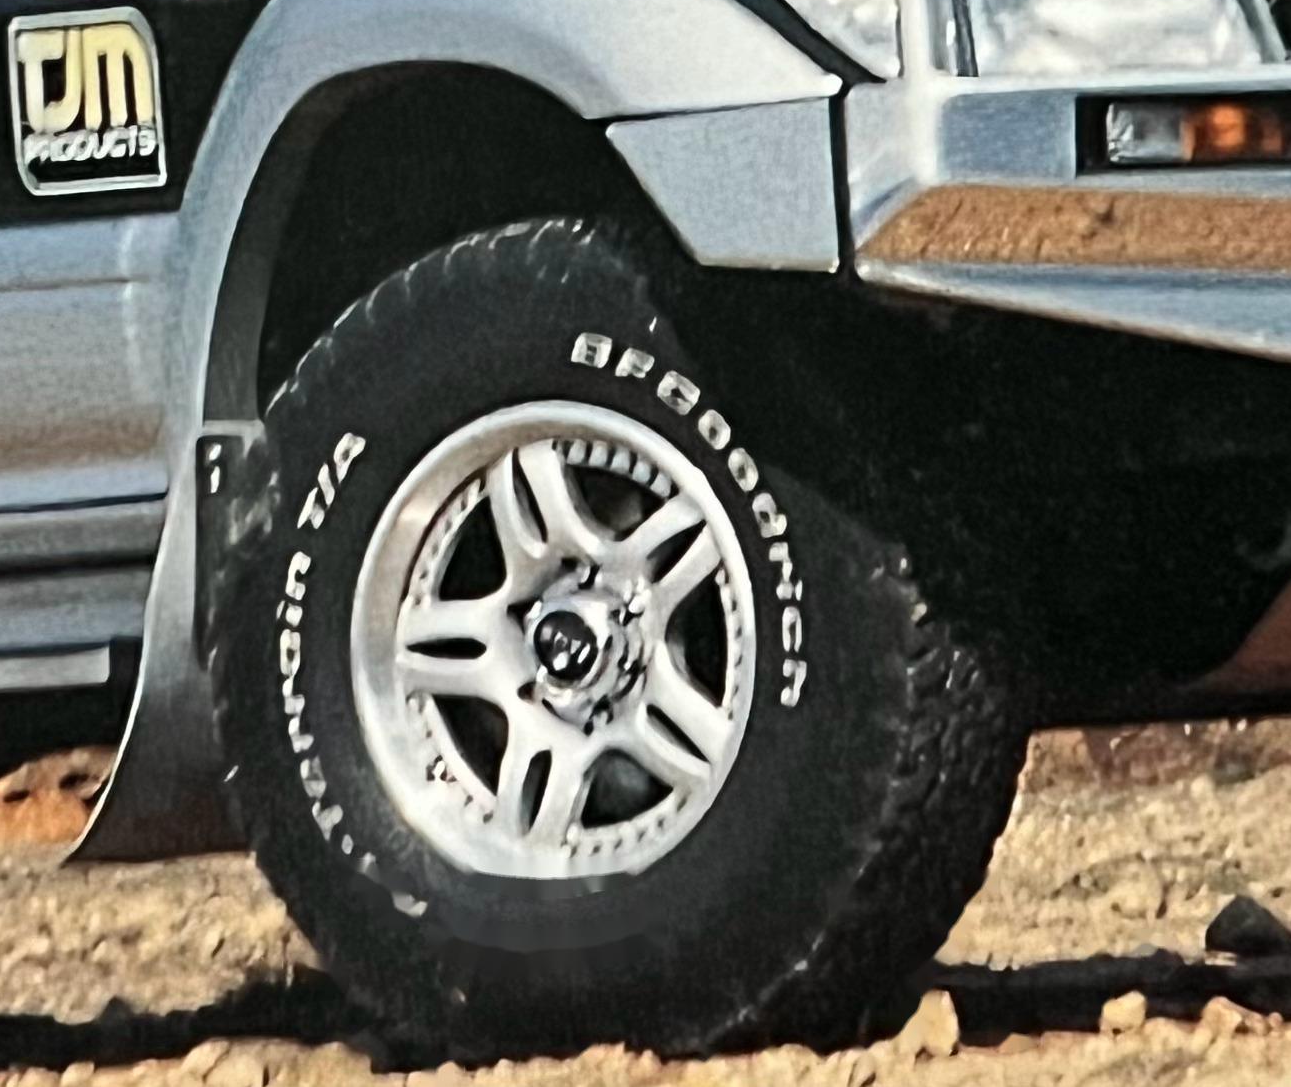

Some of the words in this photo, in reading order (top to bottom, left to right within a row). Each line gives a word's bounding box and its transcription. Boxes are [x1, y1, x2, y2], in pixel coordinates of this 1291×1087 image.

[17, 23, 155, 135] TJM
[23, 125, 158, 165] PRODUCTS
[296, 431, 367, 530] T/A
